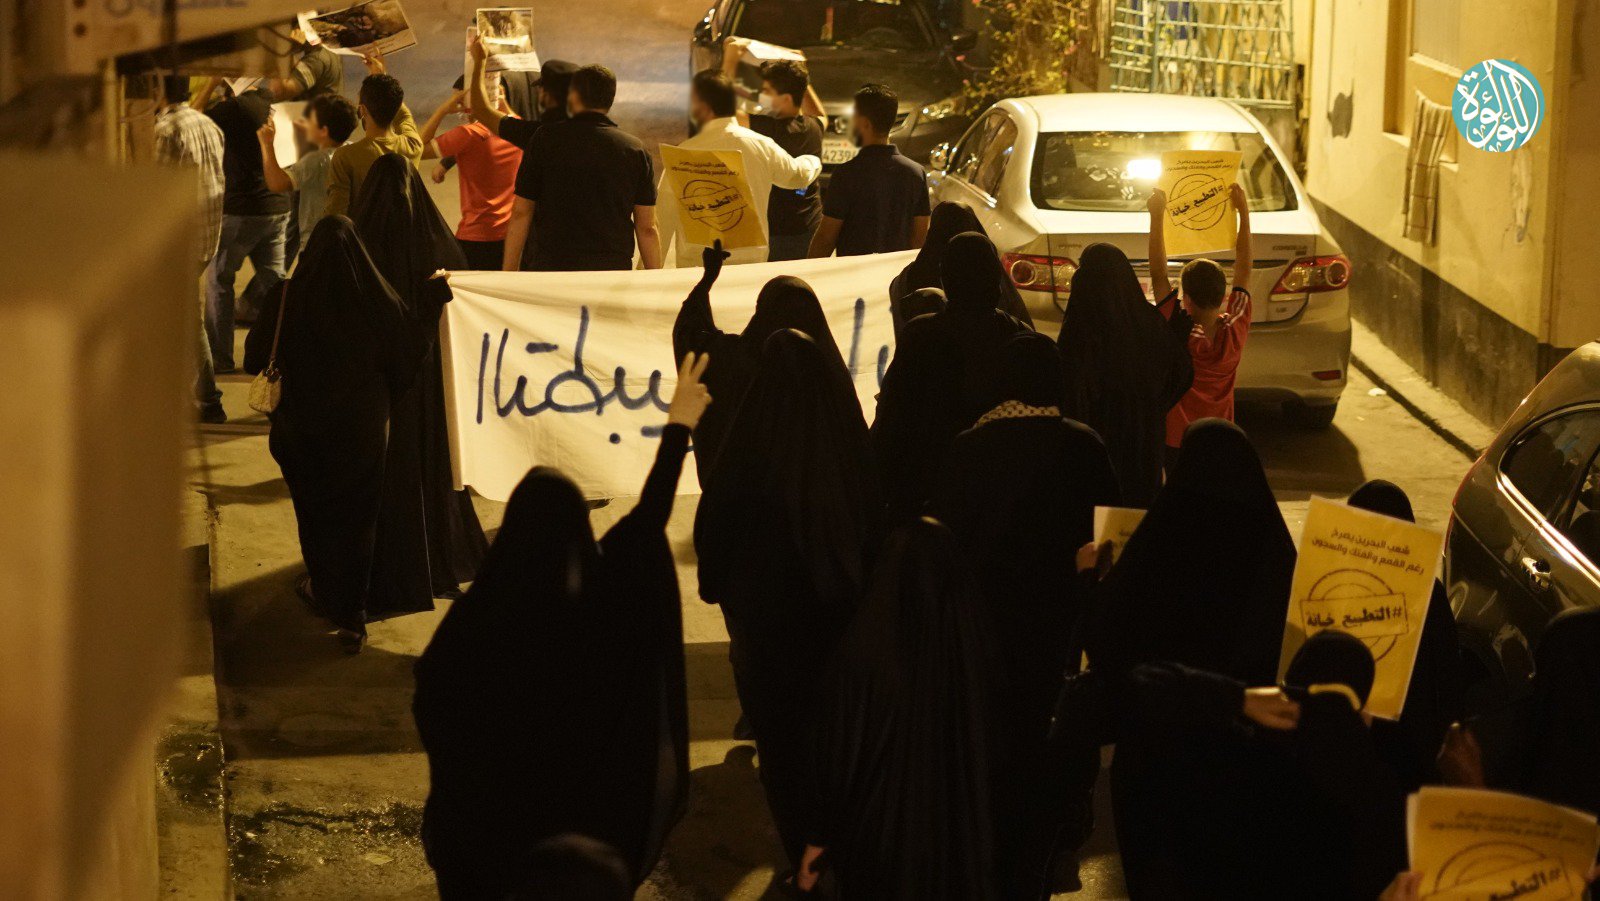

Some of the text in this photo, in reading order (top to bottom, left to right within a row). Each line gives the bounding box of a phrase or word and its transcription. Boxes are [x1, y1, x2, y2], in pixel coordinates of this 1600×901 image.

[822, 150, 858, 161] 4239
[1170, 202, 1190, 216] خيانة
[1331, 527, 1411, 555] شعب البحرين يصرخ
[1405, 562, 1425, 576] رغم
